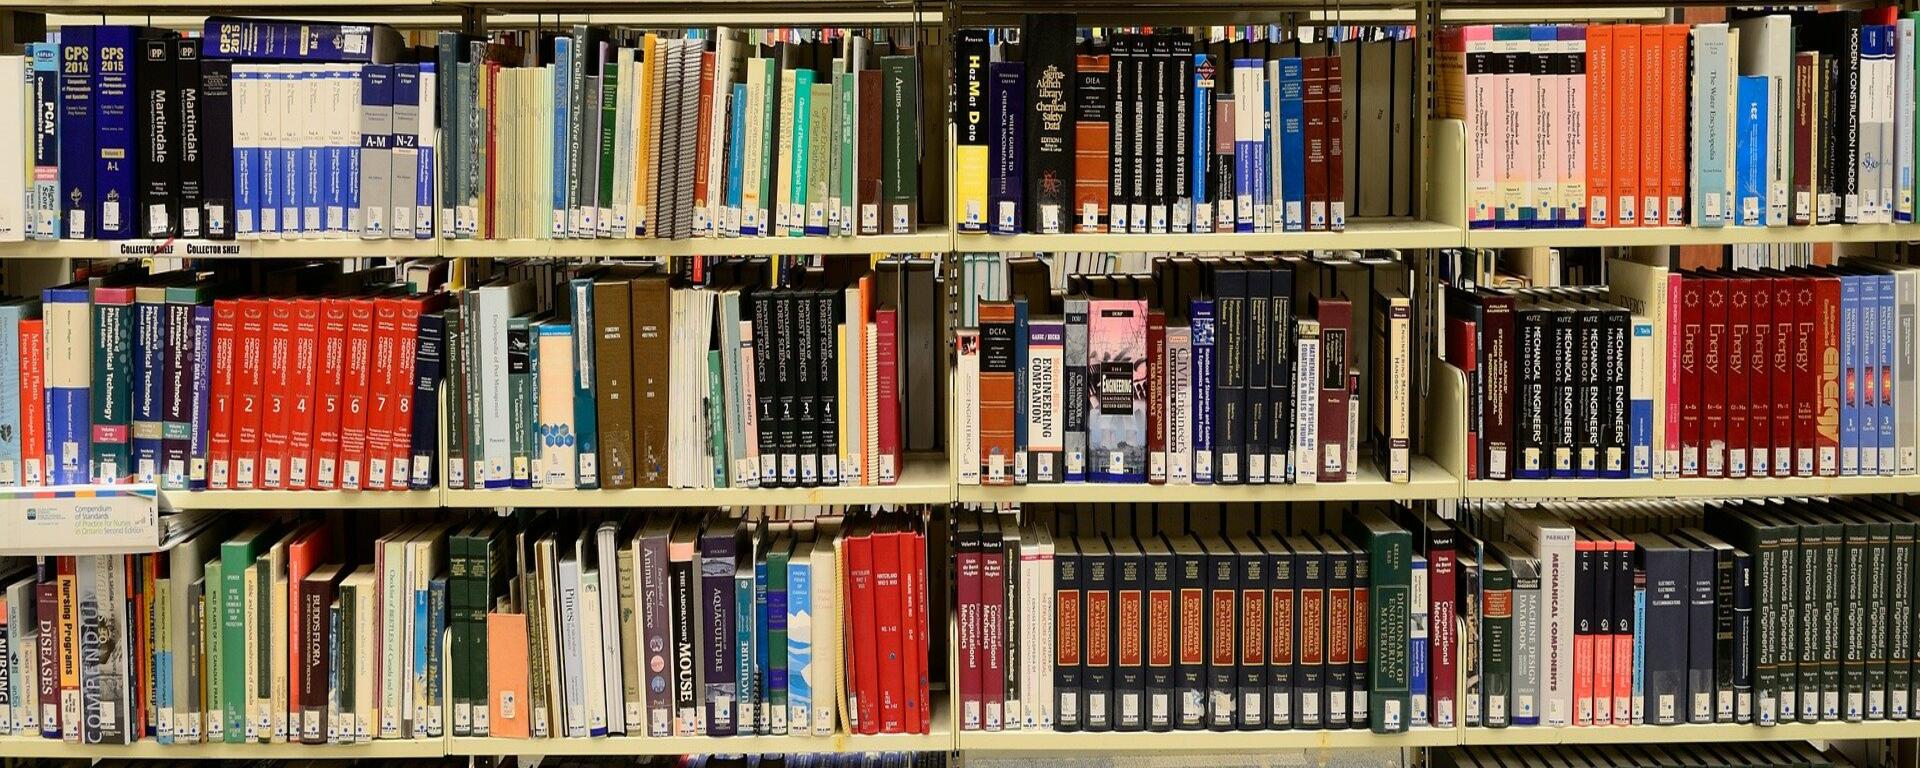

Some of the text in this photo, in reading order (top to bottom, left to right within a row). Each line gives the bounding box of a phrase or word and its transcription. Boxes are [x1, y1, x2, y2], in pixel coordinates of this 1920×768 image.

[64, 46, 89, 60] CPS
[102, 47, 124, 60] CPS
[220, 24, 232, 53] CPS
[231, 25, 241, 53] 2015
[310, 32, 319, 49] M-Z
[1850, 28, 1858, 70] MODERN
[65, 61, 88, 73] 2014
[102, 61, 124, 72] 2015
[968, 55, 980, 141] HazMat Data
[1036, 102, 1066, 112] Chemical
[1040, 90, 1063, 100] Library
[1849, 72, 1857, 146] CONSTRUCTION
[44, 102, 54, 135] PCAT
[156, 90, 168, 162] Martindale
[186, 88, 198, 162] Martindale
[1114, 100, 1122, 155] INFORMATION
[366, 137, 386, 147] A-M
[396, 136, 414, 146] N-Z
[1708, 110, 1717, 160] Encyclopedia
[107, 162, 119, 172] A-L
[1008, 162, 1014, 171] TO
[1114, 156, 1122, 196] SYSTEMS
[104, 308, 114, 420] Pharmaceutical Technology
[142, 306, 152, 417] Pharmaceutical Technology
[1300, 344, 1308, 382] EQUATIONS
[1682, 324, 1700, 374] Energy
[1706, 324, 1722, 374] Energy
[1730, 324, 1748, 374] Energy
[1102, 374, 1132, 393] ENGINEERING
[1308, 344, 1316, 394] MATHEMATICAL
[200, 380, 206, 390] OF
[1032, 358, 1042, 424] COMPANION
[1042, 358, 1052, 438] ENGINEERING
[1300, 390, 1308, 409] RULES
[1533, 326, 1542, 445] MECHANICAL ENGINEERS'
[1564, 328, 1574, 447] MECHANICAL ENGINEERS'
[220, 398, 226, 412] 1
[245, 398, 253, 412] 2
[272, 398, 280, 412] 3
[297, 398, 306, 412] 4
[326, 398, 335, 412] 5
[351, 399, 360, 414] 6
[378, 396, 385, 412] 7
[400, 398, 408, 412] 8
[782, 404, 790, 414] 2
[803, 402, 810, 414] 3
[824, 403, 832, 414] 4
[1300, 410, 1308, 421] OF
[1307, 403, 1315, 434] PHYSICAL
[1300, 423, 1308, 447] THUMB
[1307, 436, 1315, 450] DAT
[644, 548, 655, 628] Animal Science
[1550, 553, 1558, 618] MECHANICAL
[565, 588, 576, 622] Pines
[1065, 600, 1071, 610] OF
[62, 580, 73, 675] Nursing Programs
[312, 594, 320, 666] BUDD'S FLORA
[713, 588, 722, 672] AQUACULTURE
[1519, 594, 1527, 650] DATABOOK
[1760, 606, 1769, 664] Engineering
[1780, 604, 1788, 661] Engineering
[1380, 608, 1388, 672] MATERIALS
[40, 620, 52, 695] DISEASES
[680, 643, 692, 702] MOUSE
[1396, 669, 1404, 684] OF
